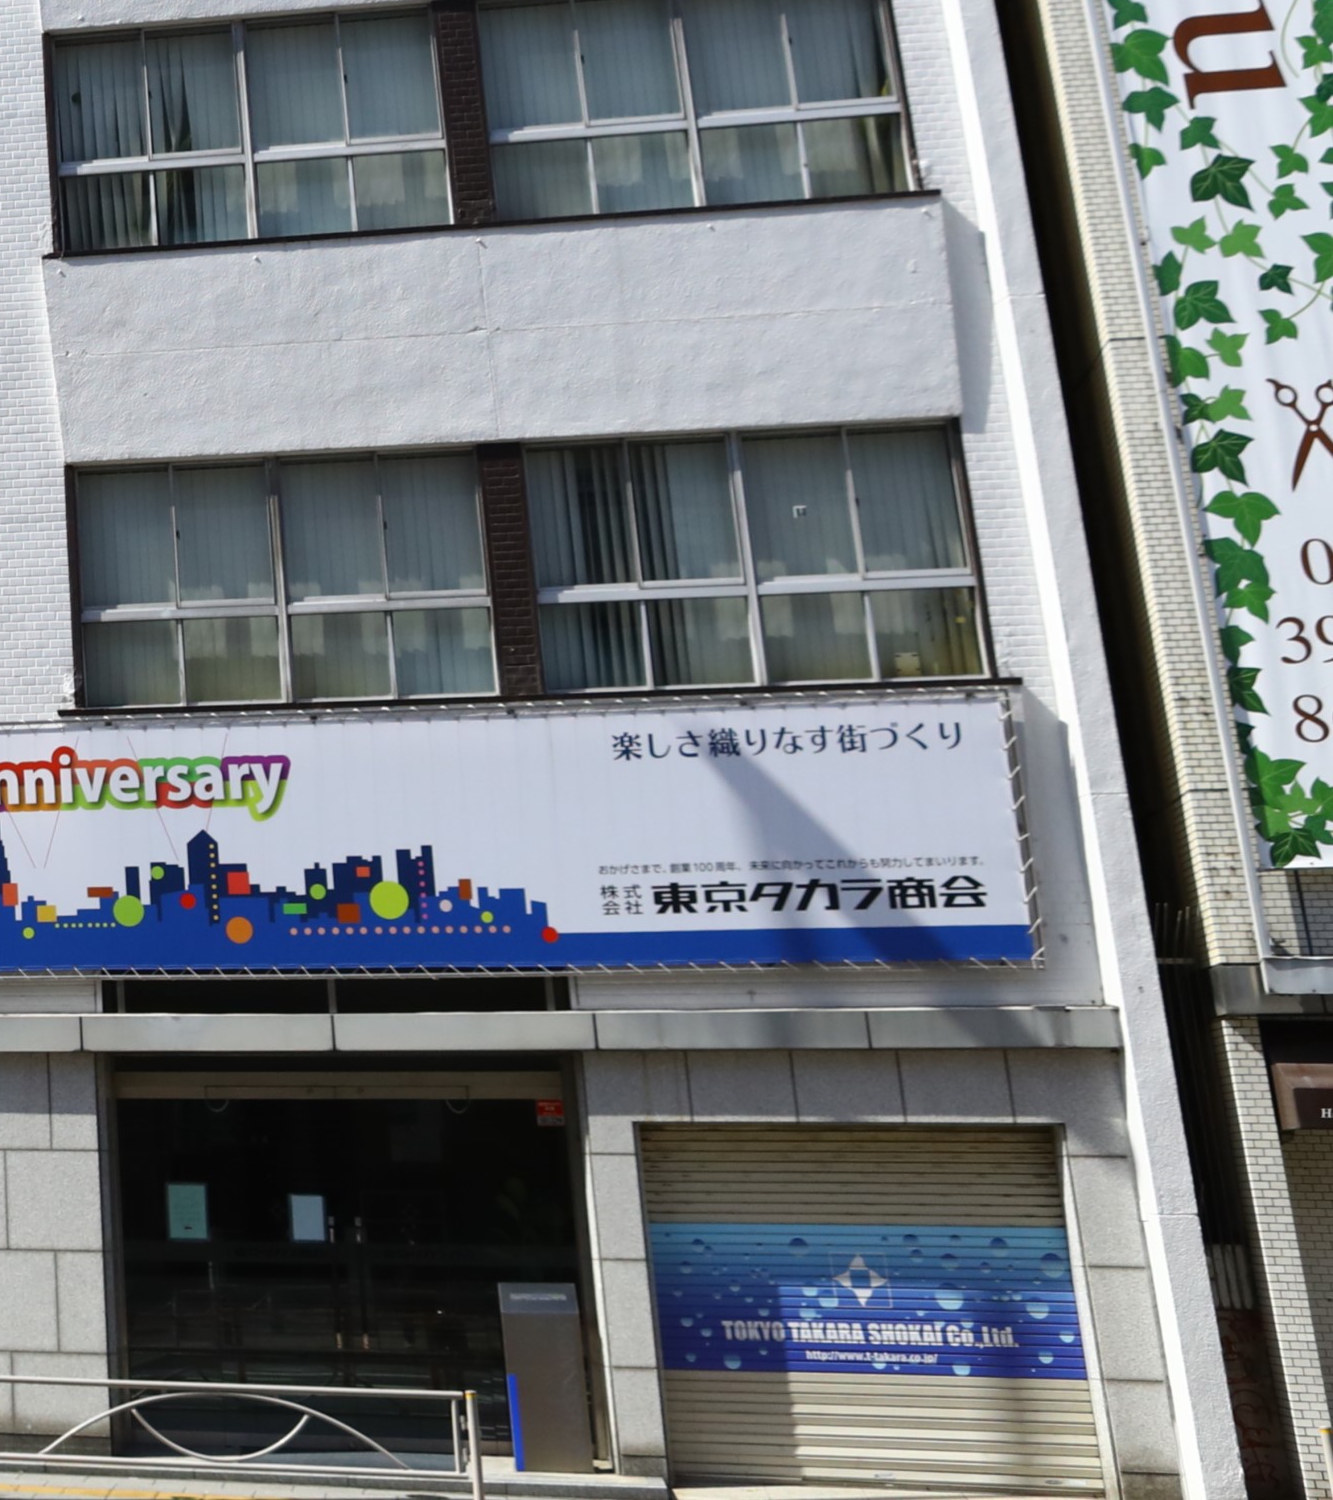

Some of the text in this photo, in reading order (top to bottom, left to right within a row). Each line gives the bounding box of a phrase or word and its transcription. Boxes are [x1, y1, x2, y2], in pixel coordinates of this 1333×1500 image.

[1291, 694, 1333, 743] 8
[611, 721, 963, 762] 楽しさ織りなす街づくり
[600, 884, 643, 901] 株式
[650, 875, 988, 915] 東京タカラ商会
[601, 901, 644, 916] 会社
[1321, 1107, 1333, 1119] H
[721, 1320, 1020, 1348] TOKYO TAKARA SHOKAI Co.,Ltd.
